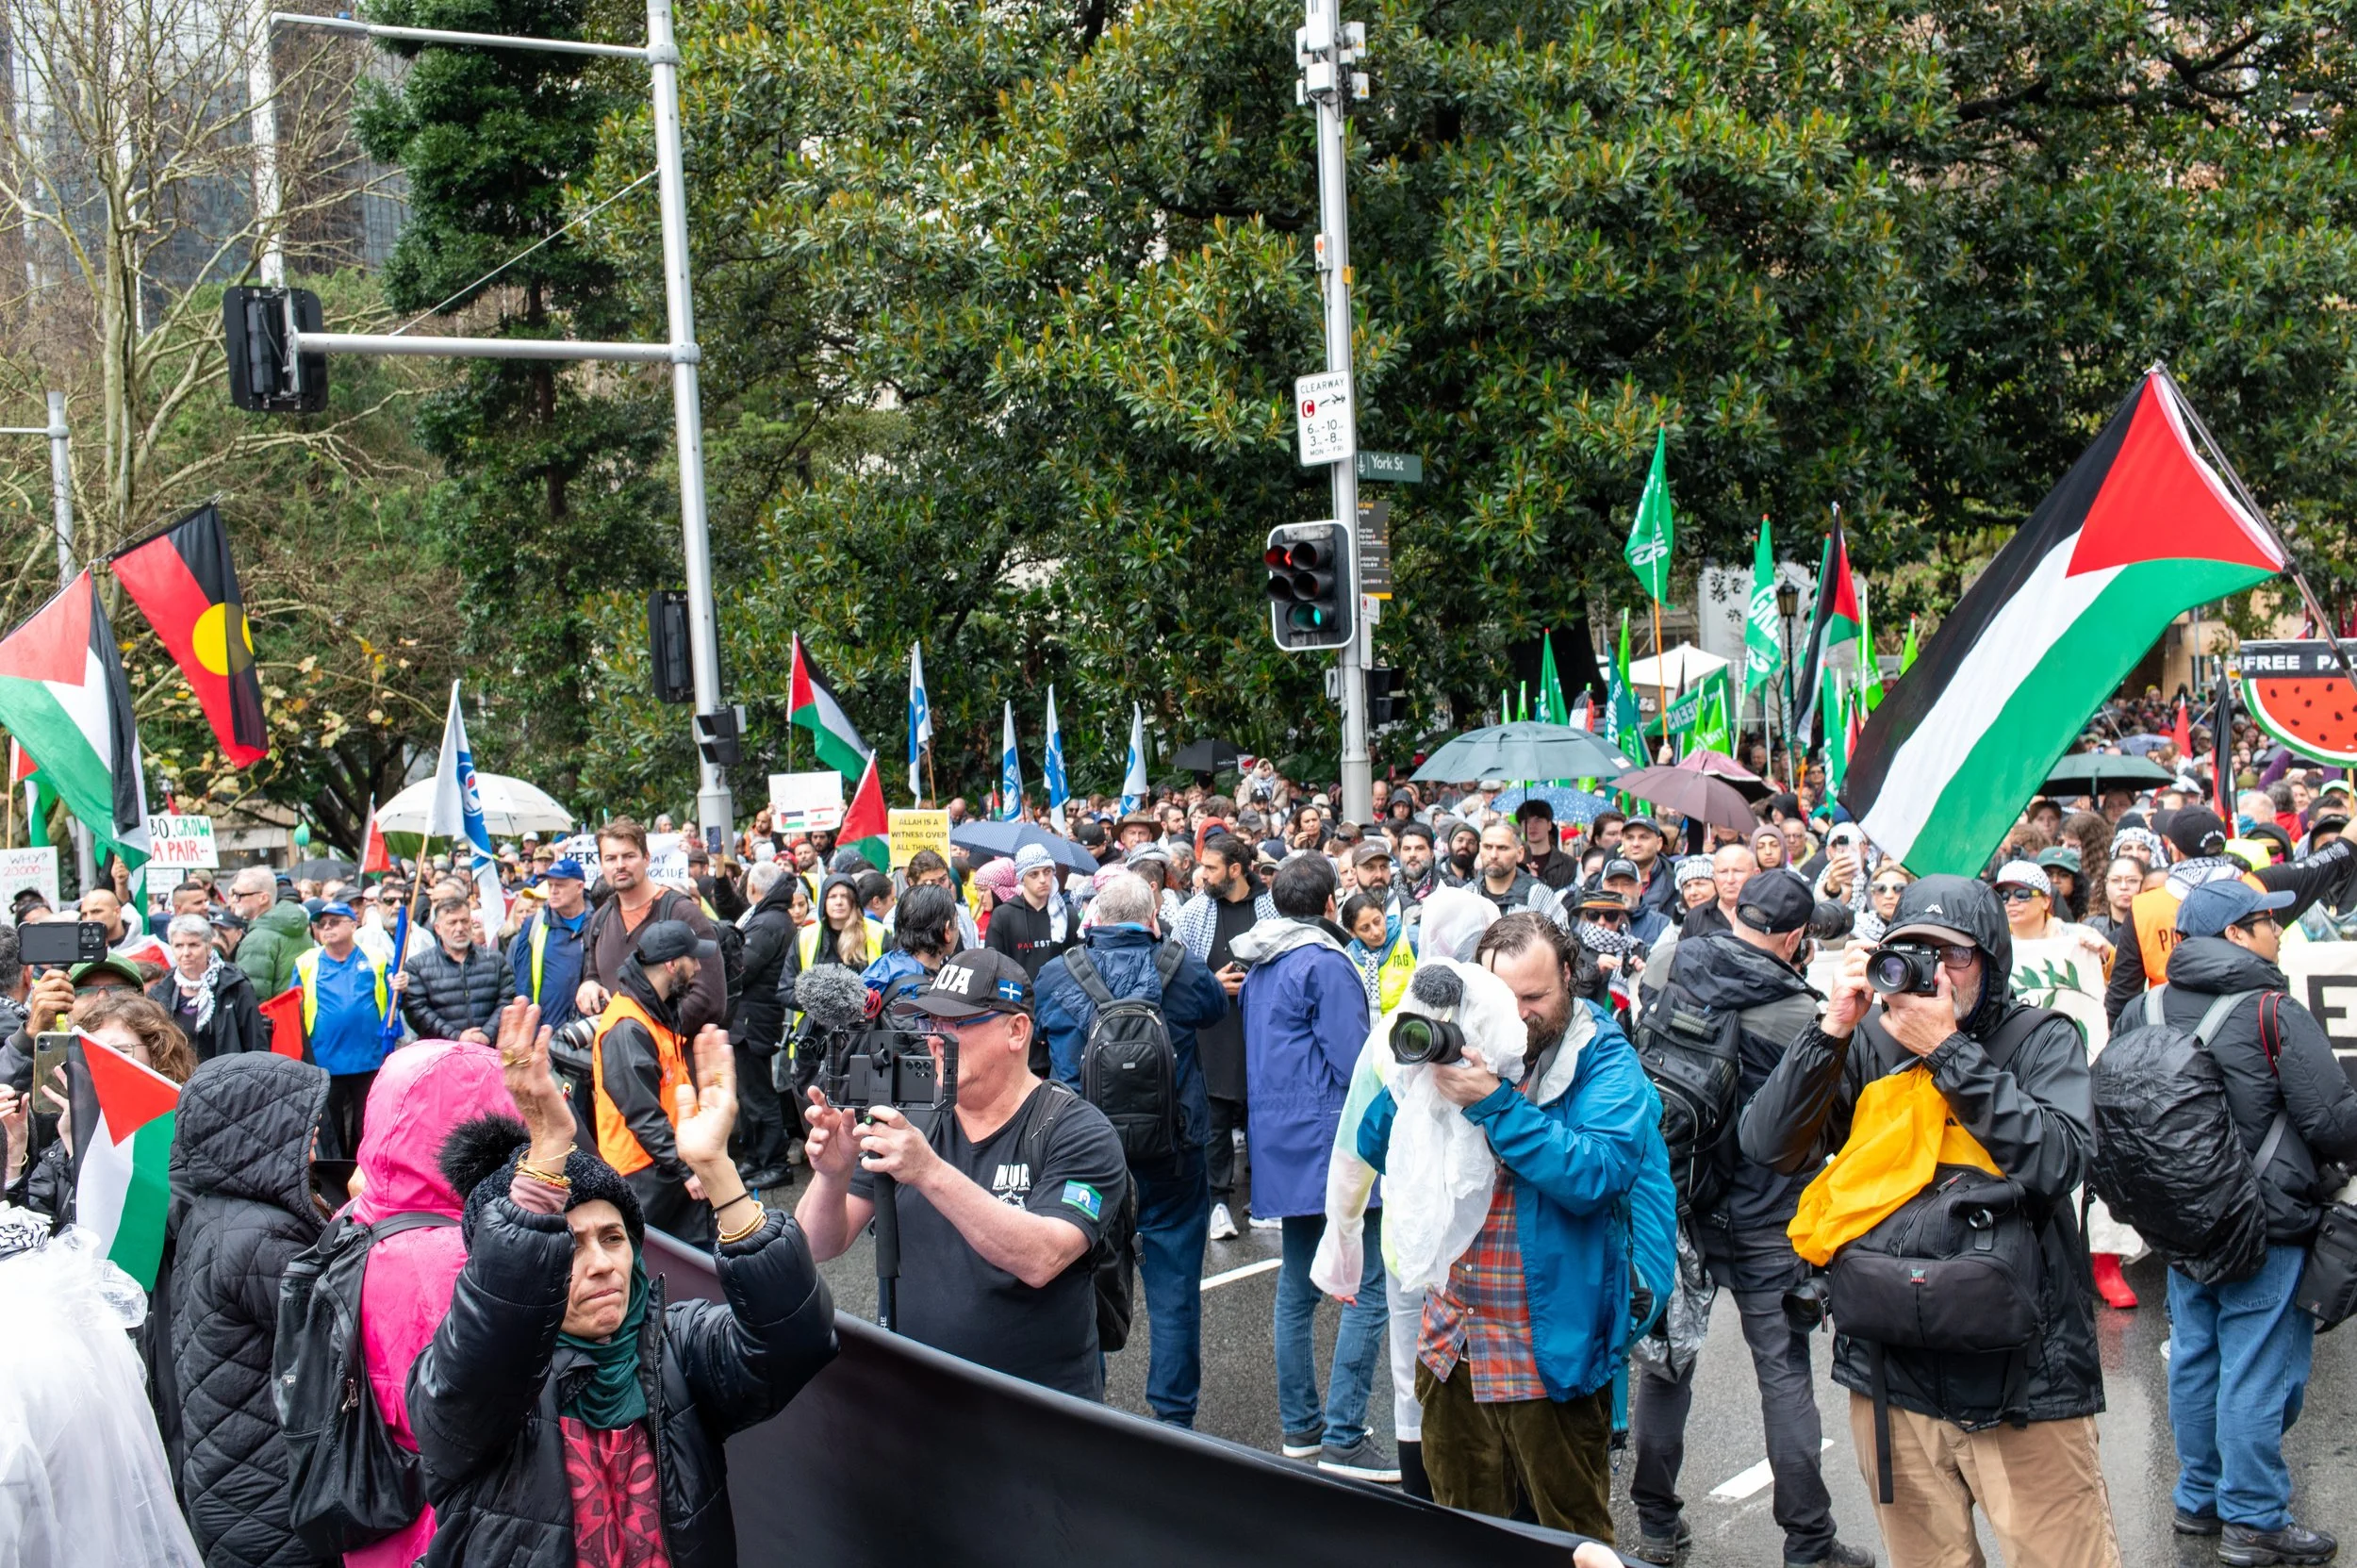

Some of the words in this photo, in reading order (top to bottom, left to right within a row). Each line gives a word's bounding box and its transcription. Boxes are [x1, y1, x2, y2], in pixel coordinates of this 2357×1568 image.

[1300, 378, 1344, 394] CLEARWAY
[1302, 400, 1315, 418] C
[1371, 454, 1393, 470] York
[1394, 456, 1404, 470] St
[2243, 655, 2300, 670] FREE
[175, 817, 210, 837] GROW
[898, 817, 922, 826] ALLAH
[923, 817, 932, 826] IS
[932, 817, 939, 825] A
[891, 831, 924, 839] WITNESS
[925, 831, 948, 839] OVER
[152, 840, 164, 862] A
[896, 844, 911, 852] ALL
[9, 851, 48, 865] WHY?
[993, 1163, 1031, 1187] MUA
